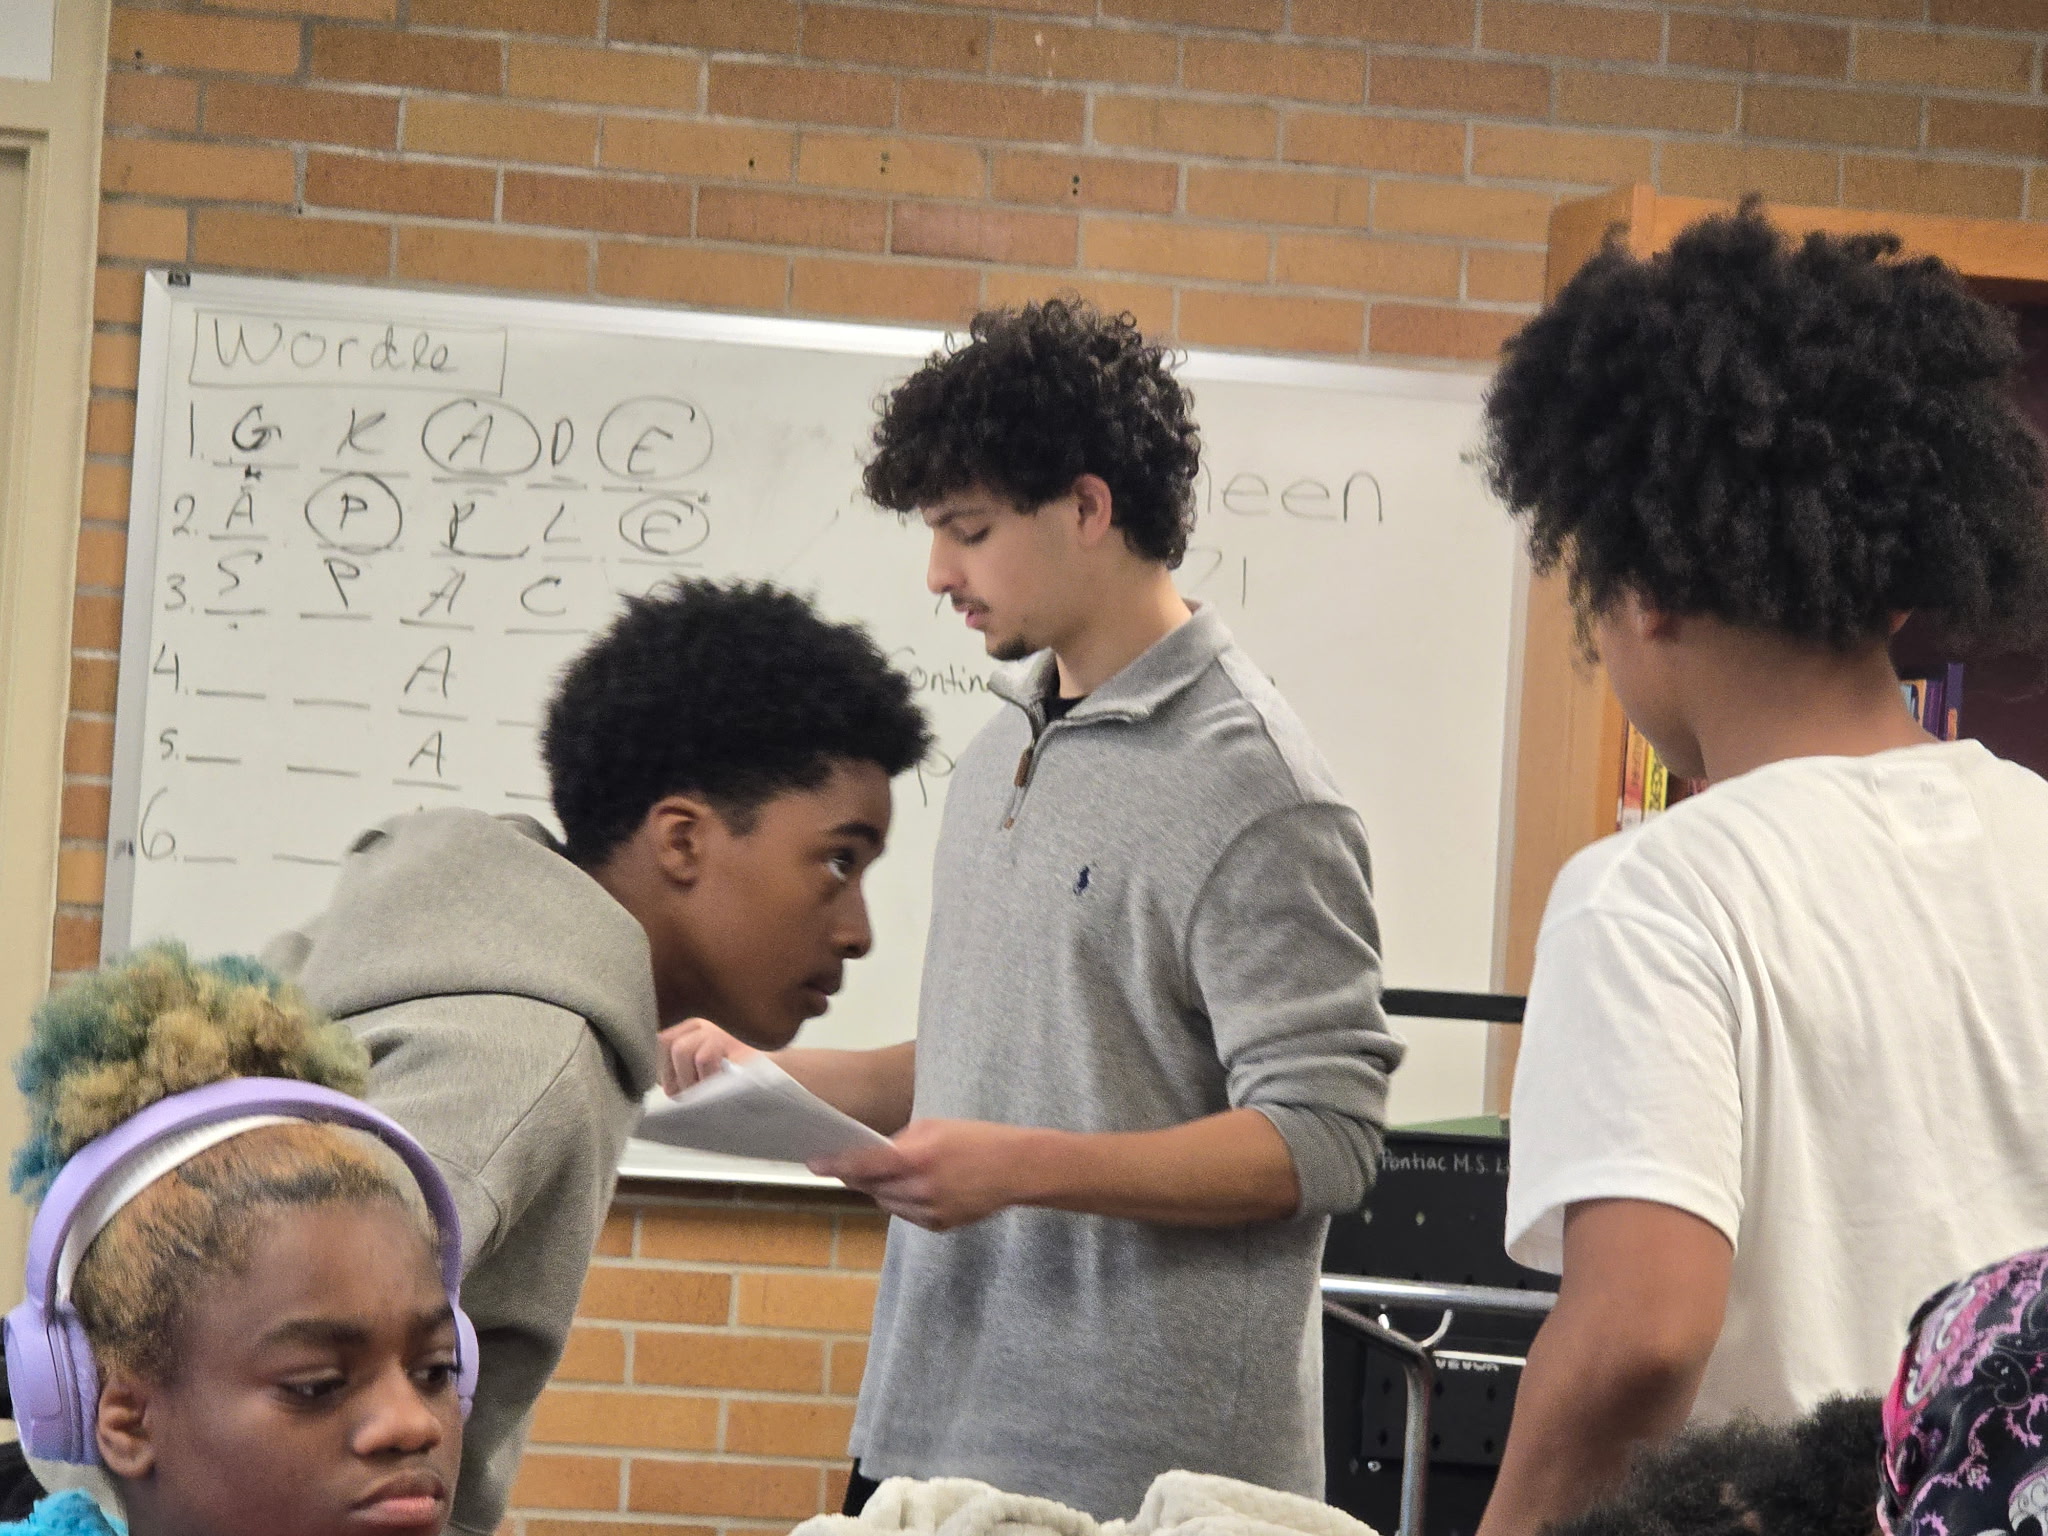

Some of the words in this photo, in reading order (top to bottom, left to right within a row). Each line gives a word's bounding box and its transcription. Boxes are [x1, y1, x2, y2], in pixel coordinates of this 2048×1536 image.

[213, 317, 459, 373] Wordle
[231, 404, 283, 452] G
[448, 414, 494, 464] A
[551, 417, 574, 467] D
[627, 425, 675, 476] E
[226, 488, 255, 530] A
[339, 492, 369, 530] P
[544, 503, 582, 544] L
[217, 549, 264, 597] S
[323, 557, 361, 610] P
[418, 567, 467, 617] A
[519, 576, 567, 615] C
[404, 645, 456, 699] A
[892, 646, 990, 695] ontin
[409, 731, 447, 777] A
[1380, 1148, 1447, 1172] Pontiac
